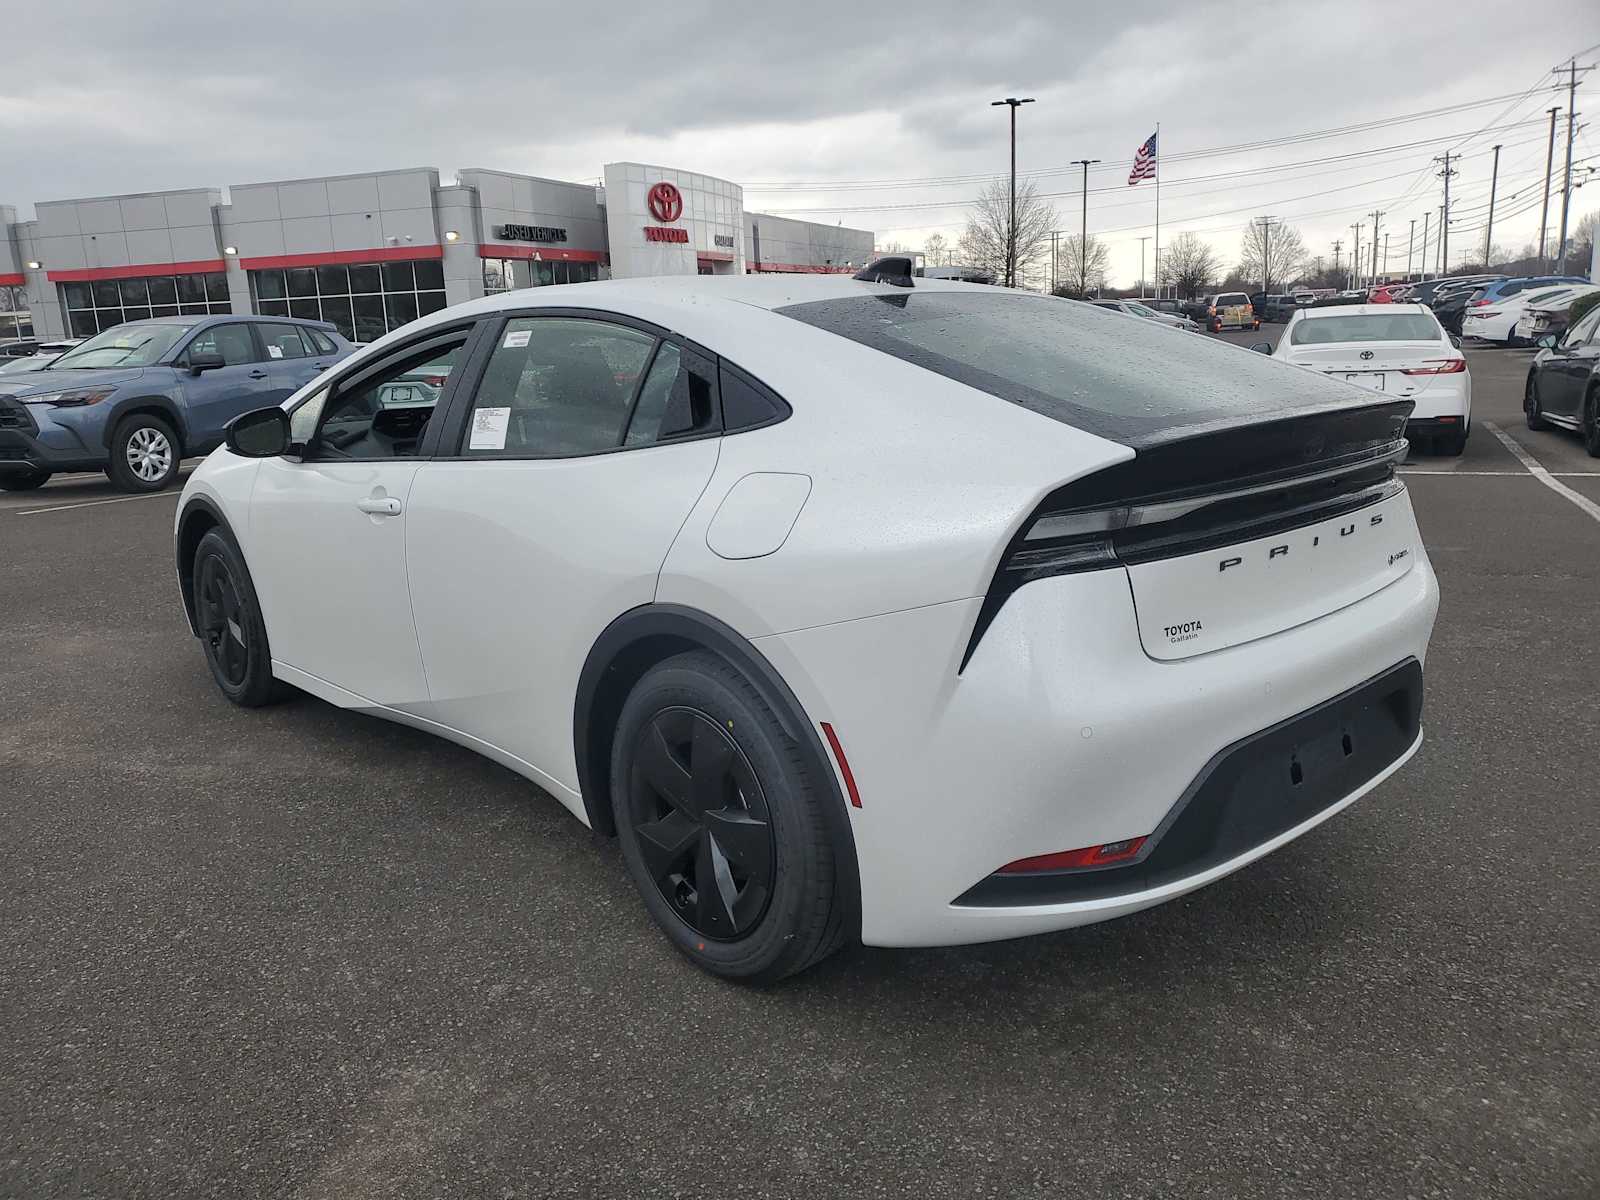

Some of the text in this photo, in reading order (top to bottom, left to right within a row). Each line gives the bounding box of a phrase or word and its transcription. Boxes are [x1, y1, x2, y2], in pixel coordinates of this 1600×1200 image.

[505, 224, 567, 242] USED VEHICLES
[643, 227, 689, 243] TOYOTA
[1220, 514, 1383, 572] PRIUS
[1164, 621, 1202, 637] TOYOTA
[1171, 633, 1198, 643] Gallatin
